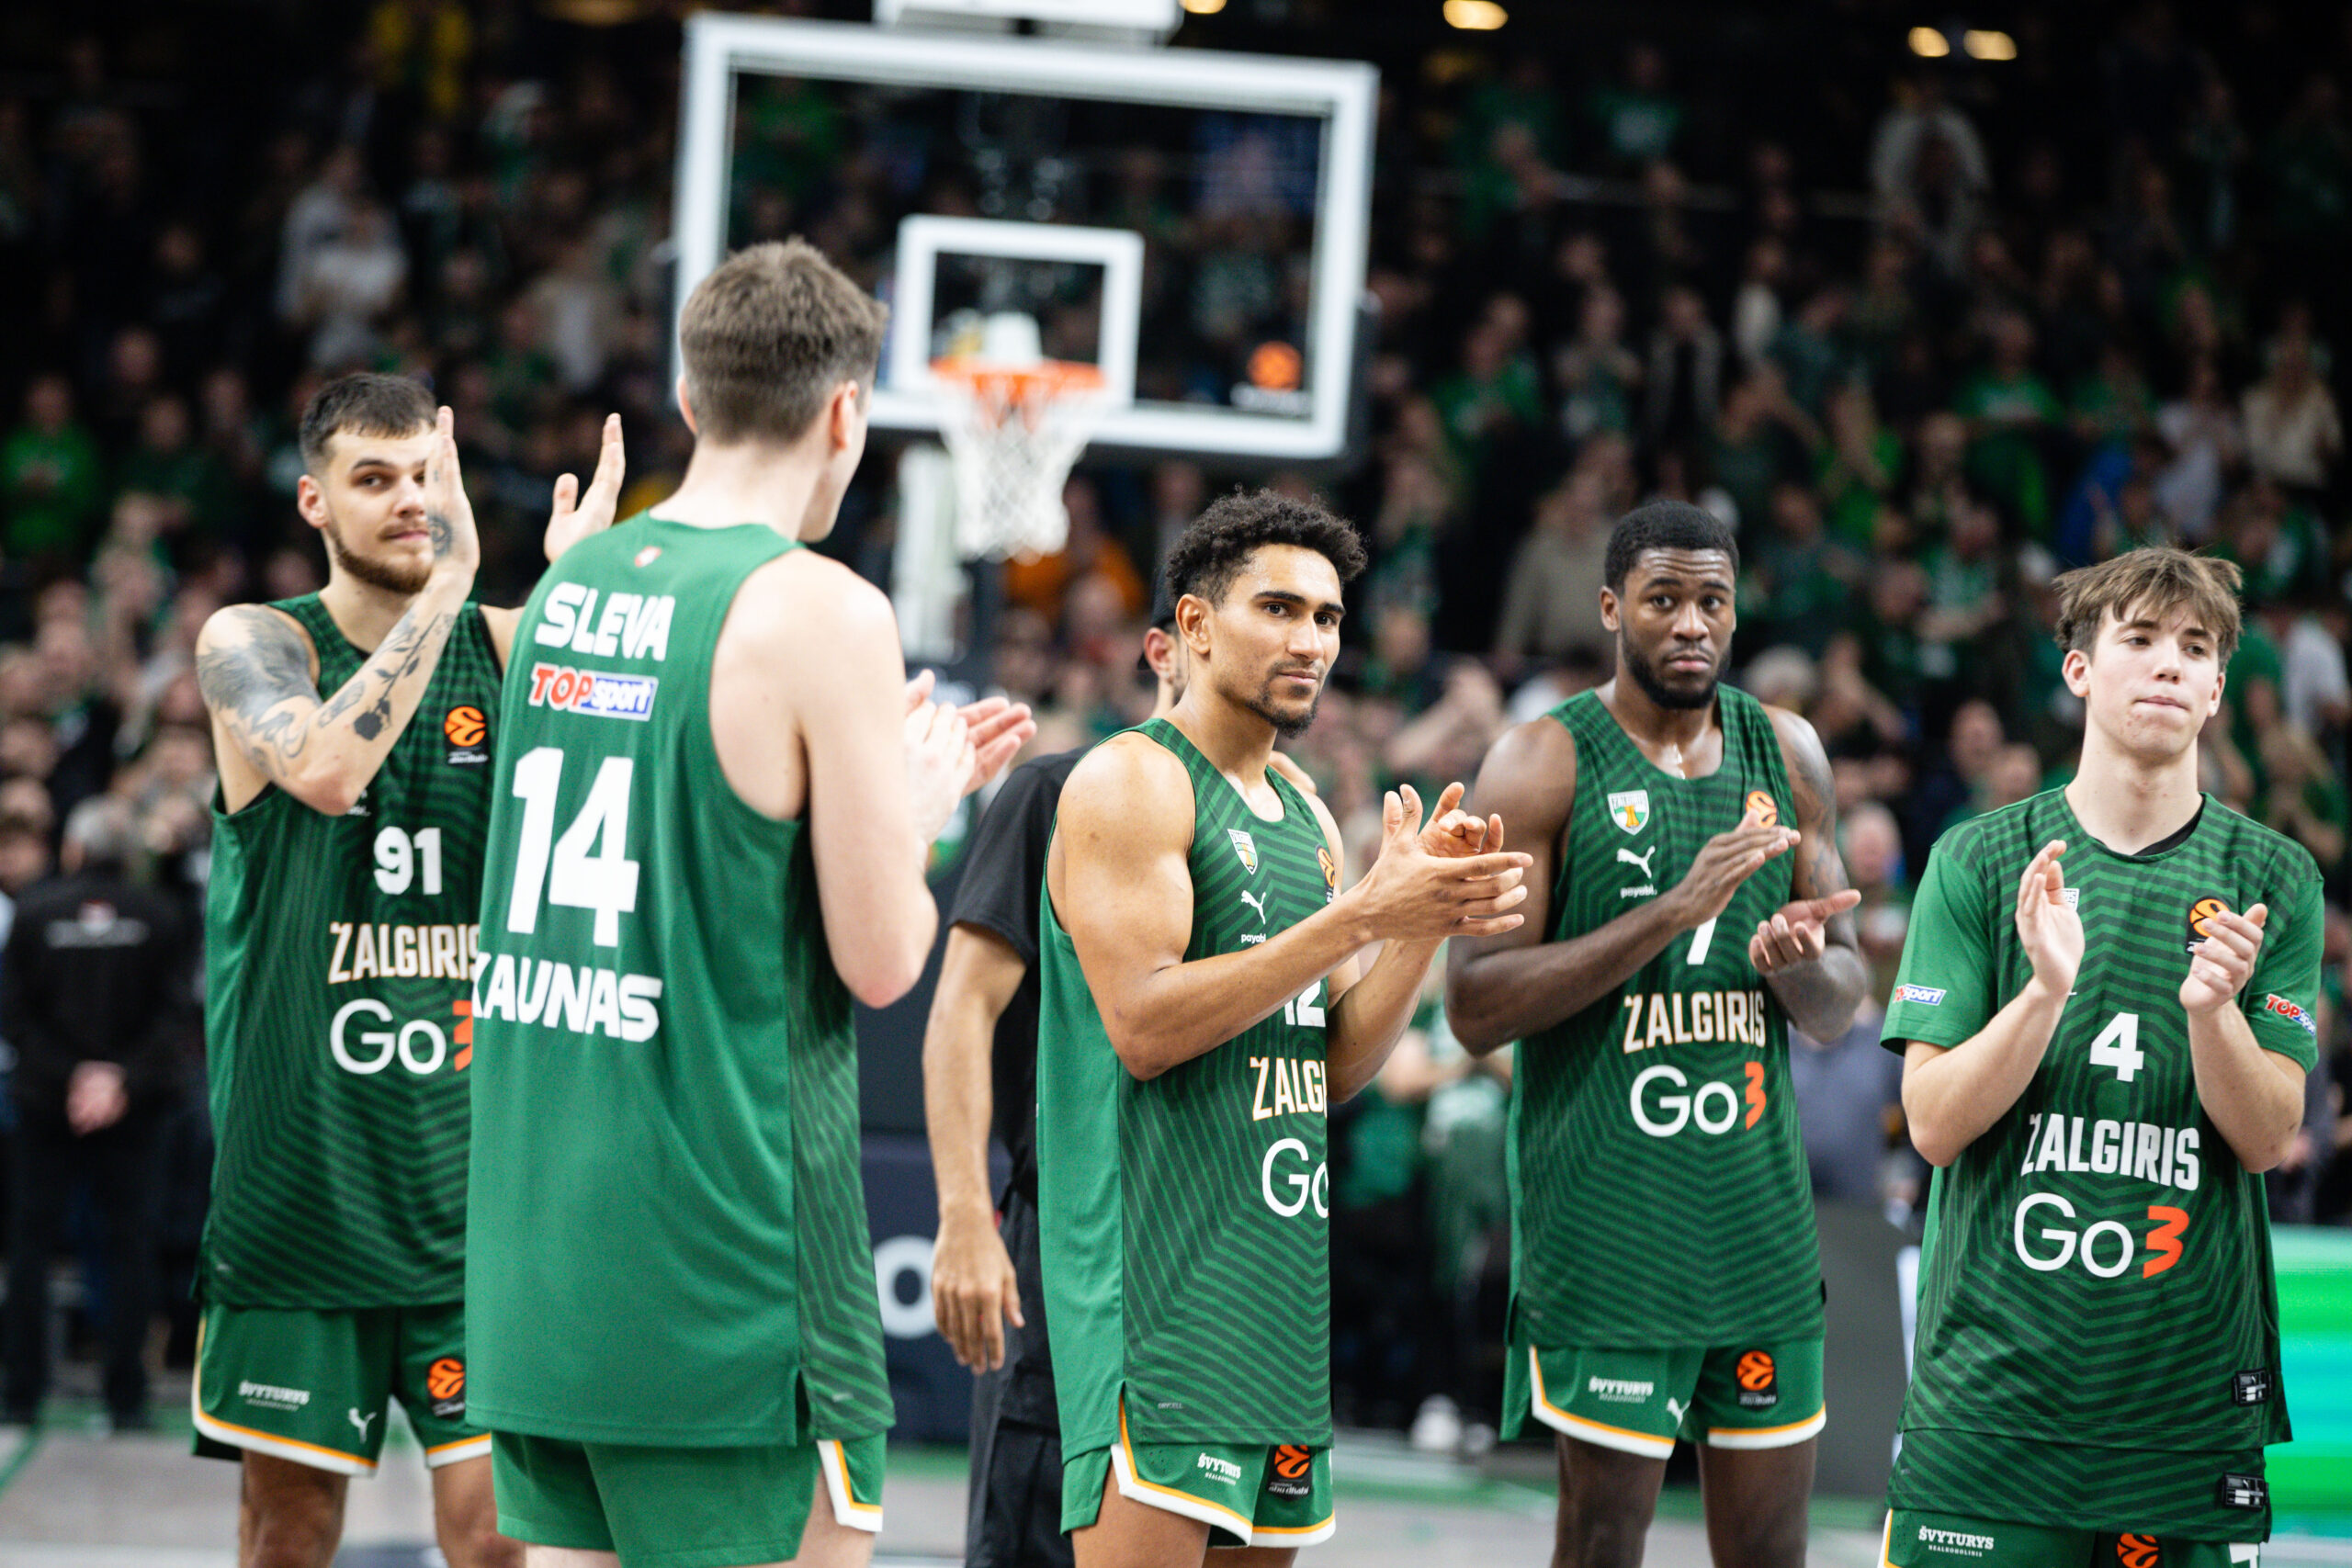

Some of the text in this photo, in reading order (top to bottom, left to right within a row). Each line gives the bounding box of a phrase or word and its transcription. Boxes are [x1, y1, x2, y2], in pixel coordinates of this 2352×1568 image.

[535, 581, 675, 662] SLEVA
[373, 827, 442, 895] 91
[507, 747, 639, 947] 14
[2089, 1012, 2144, 1082] 4
[1630, 1061, 1767, 1137] Go3
[2014, 1192, 2190, 1279] Go3
